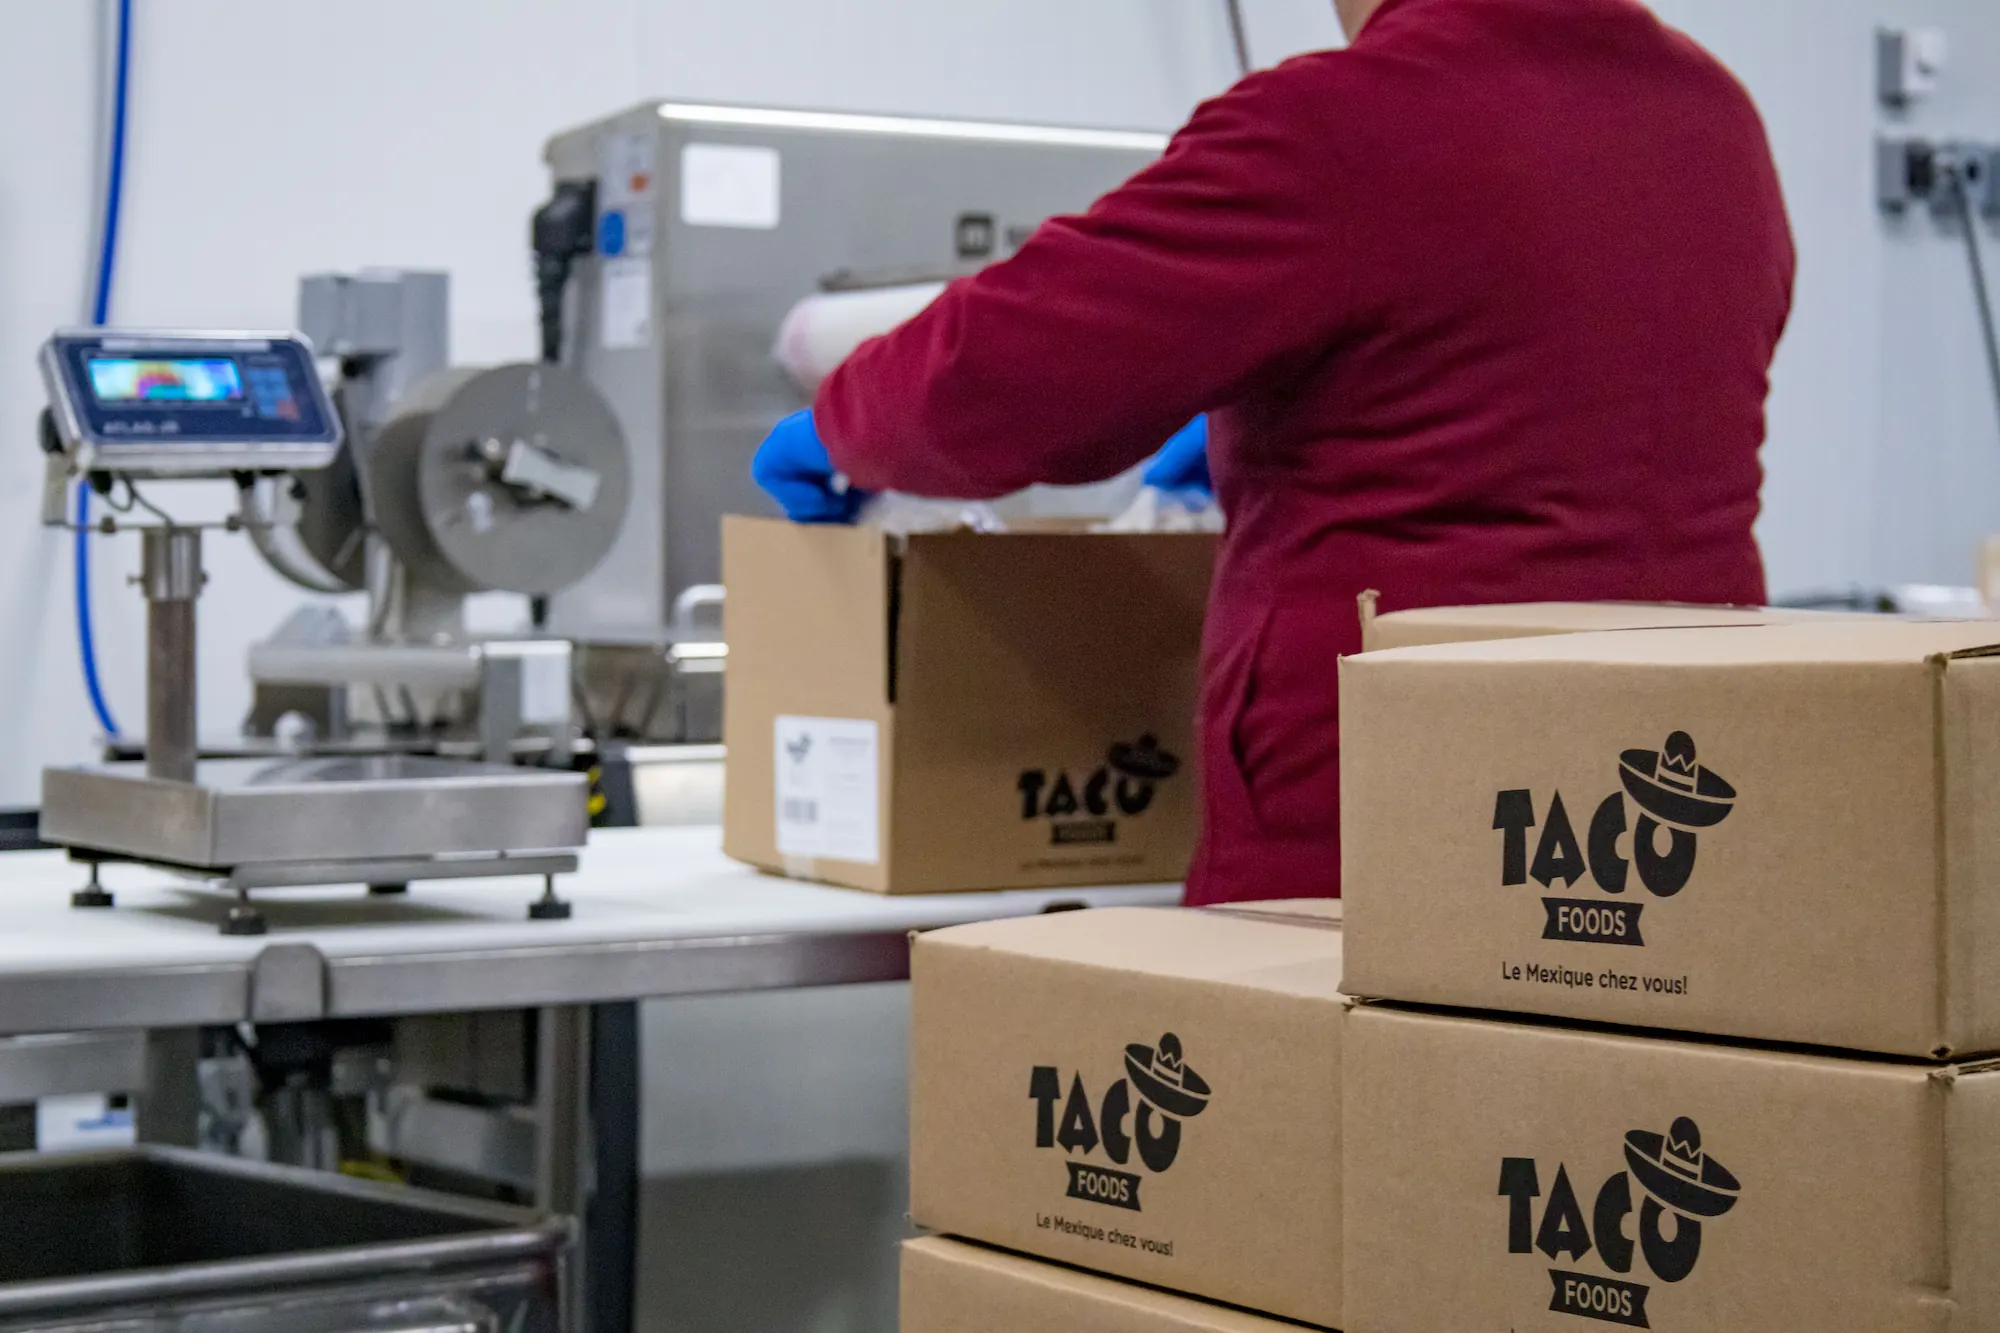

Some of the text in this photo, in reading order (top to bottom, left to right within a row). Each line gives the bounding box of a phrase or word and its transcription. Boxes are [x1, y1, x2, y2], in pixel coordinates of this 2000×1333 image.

[1018, 767, 1154, 820] TACO
[1492, 788, 1697, 898] TACO
[1557, 905, 1627, 937] FOODS
[1502, 961, 1687, 995] Le Mexique chez vous!
[1028, 1065, 1182, 1173] TACO
[1076, 1169, 1130, 1202] FOODS
[1036, 1212, 1174, 1257] Le Mexique chez vous!
[1498, 1157, 1702, 1283] TACO
[1564, 1279, 1633, 1317] FOODS
